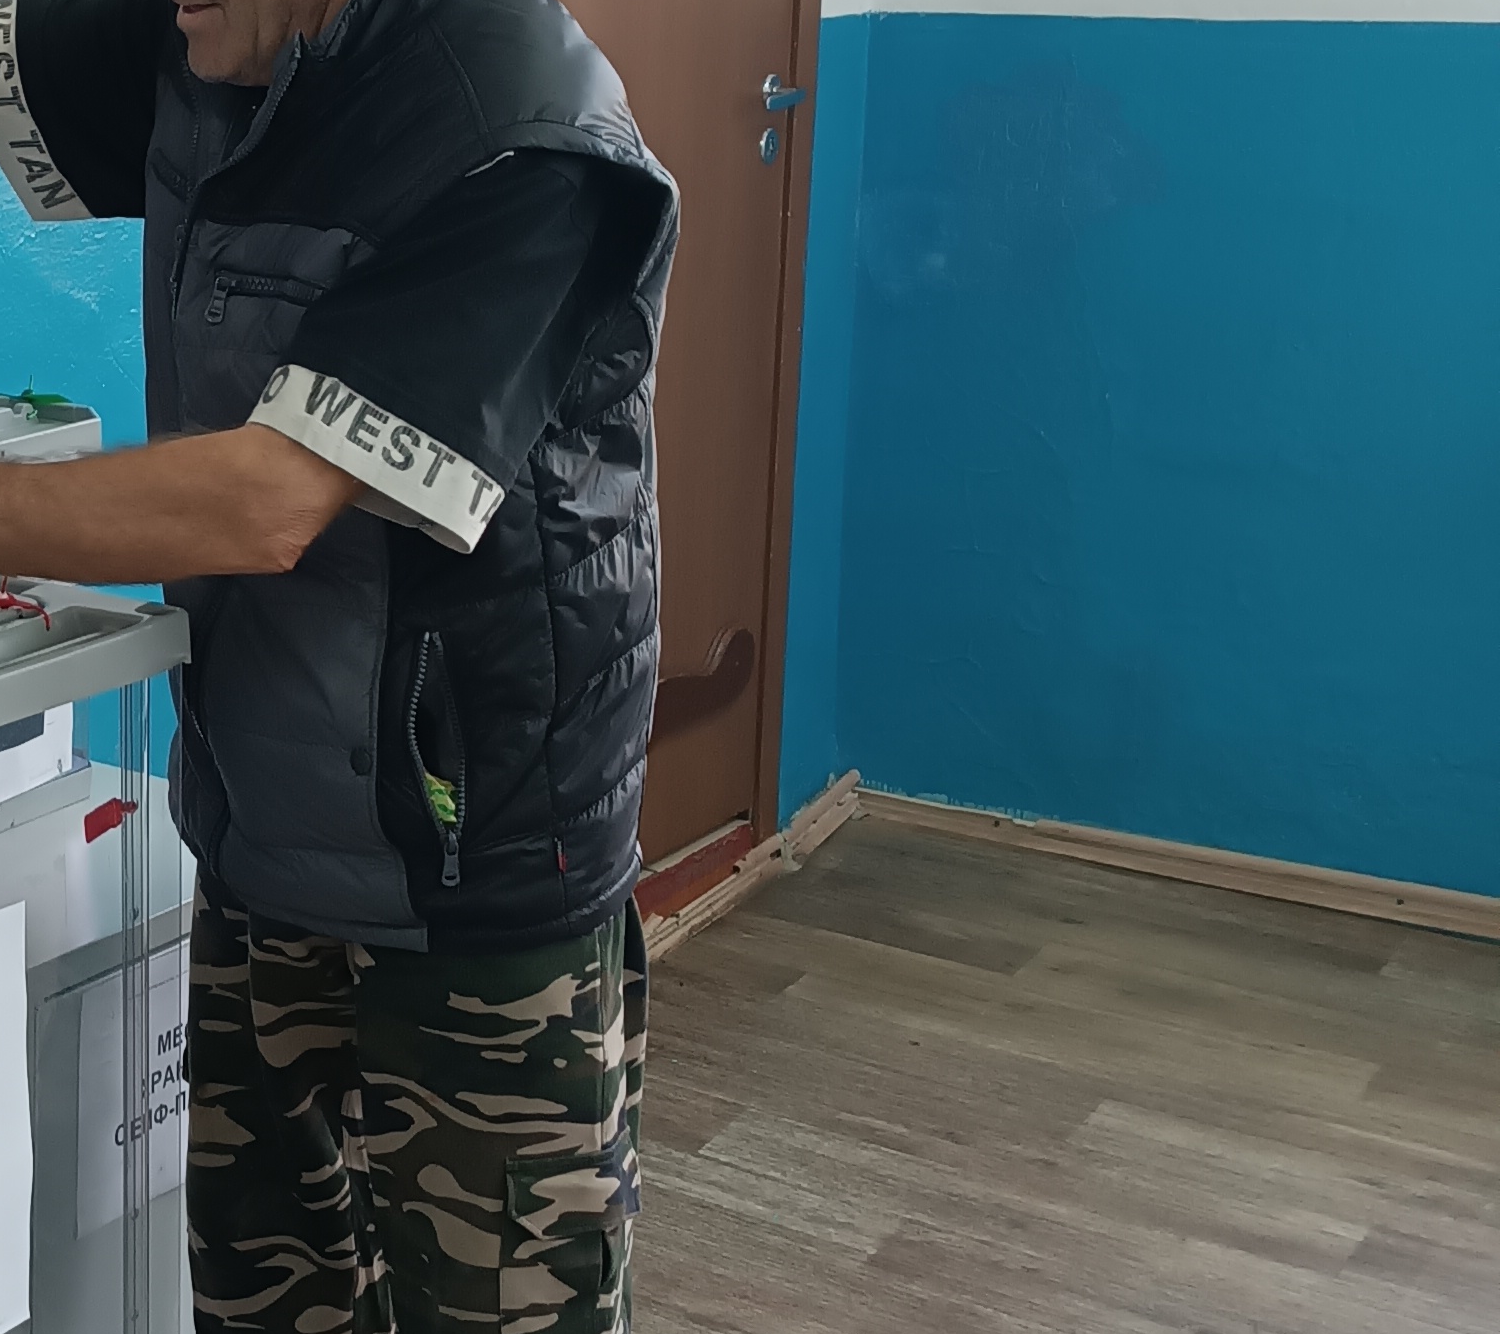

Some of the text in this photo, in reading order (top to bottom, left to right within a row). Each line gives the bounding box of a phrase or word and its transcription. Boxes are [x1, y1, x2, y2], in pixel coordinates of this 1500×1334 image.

[9, 129, 77, 209] TAN
[304, 374, 456, 488] WEST
[158, 1023, 188, 1056] МЕ
[115, 1090, 189, 1146] СЕФ-П
